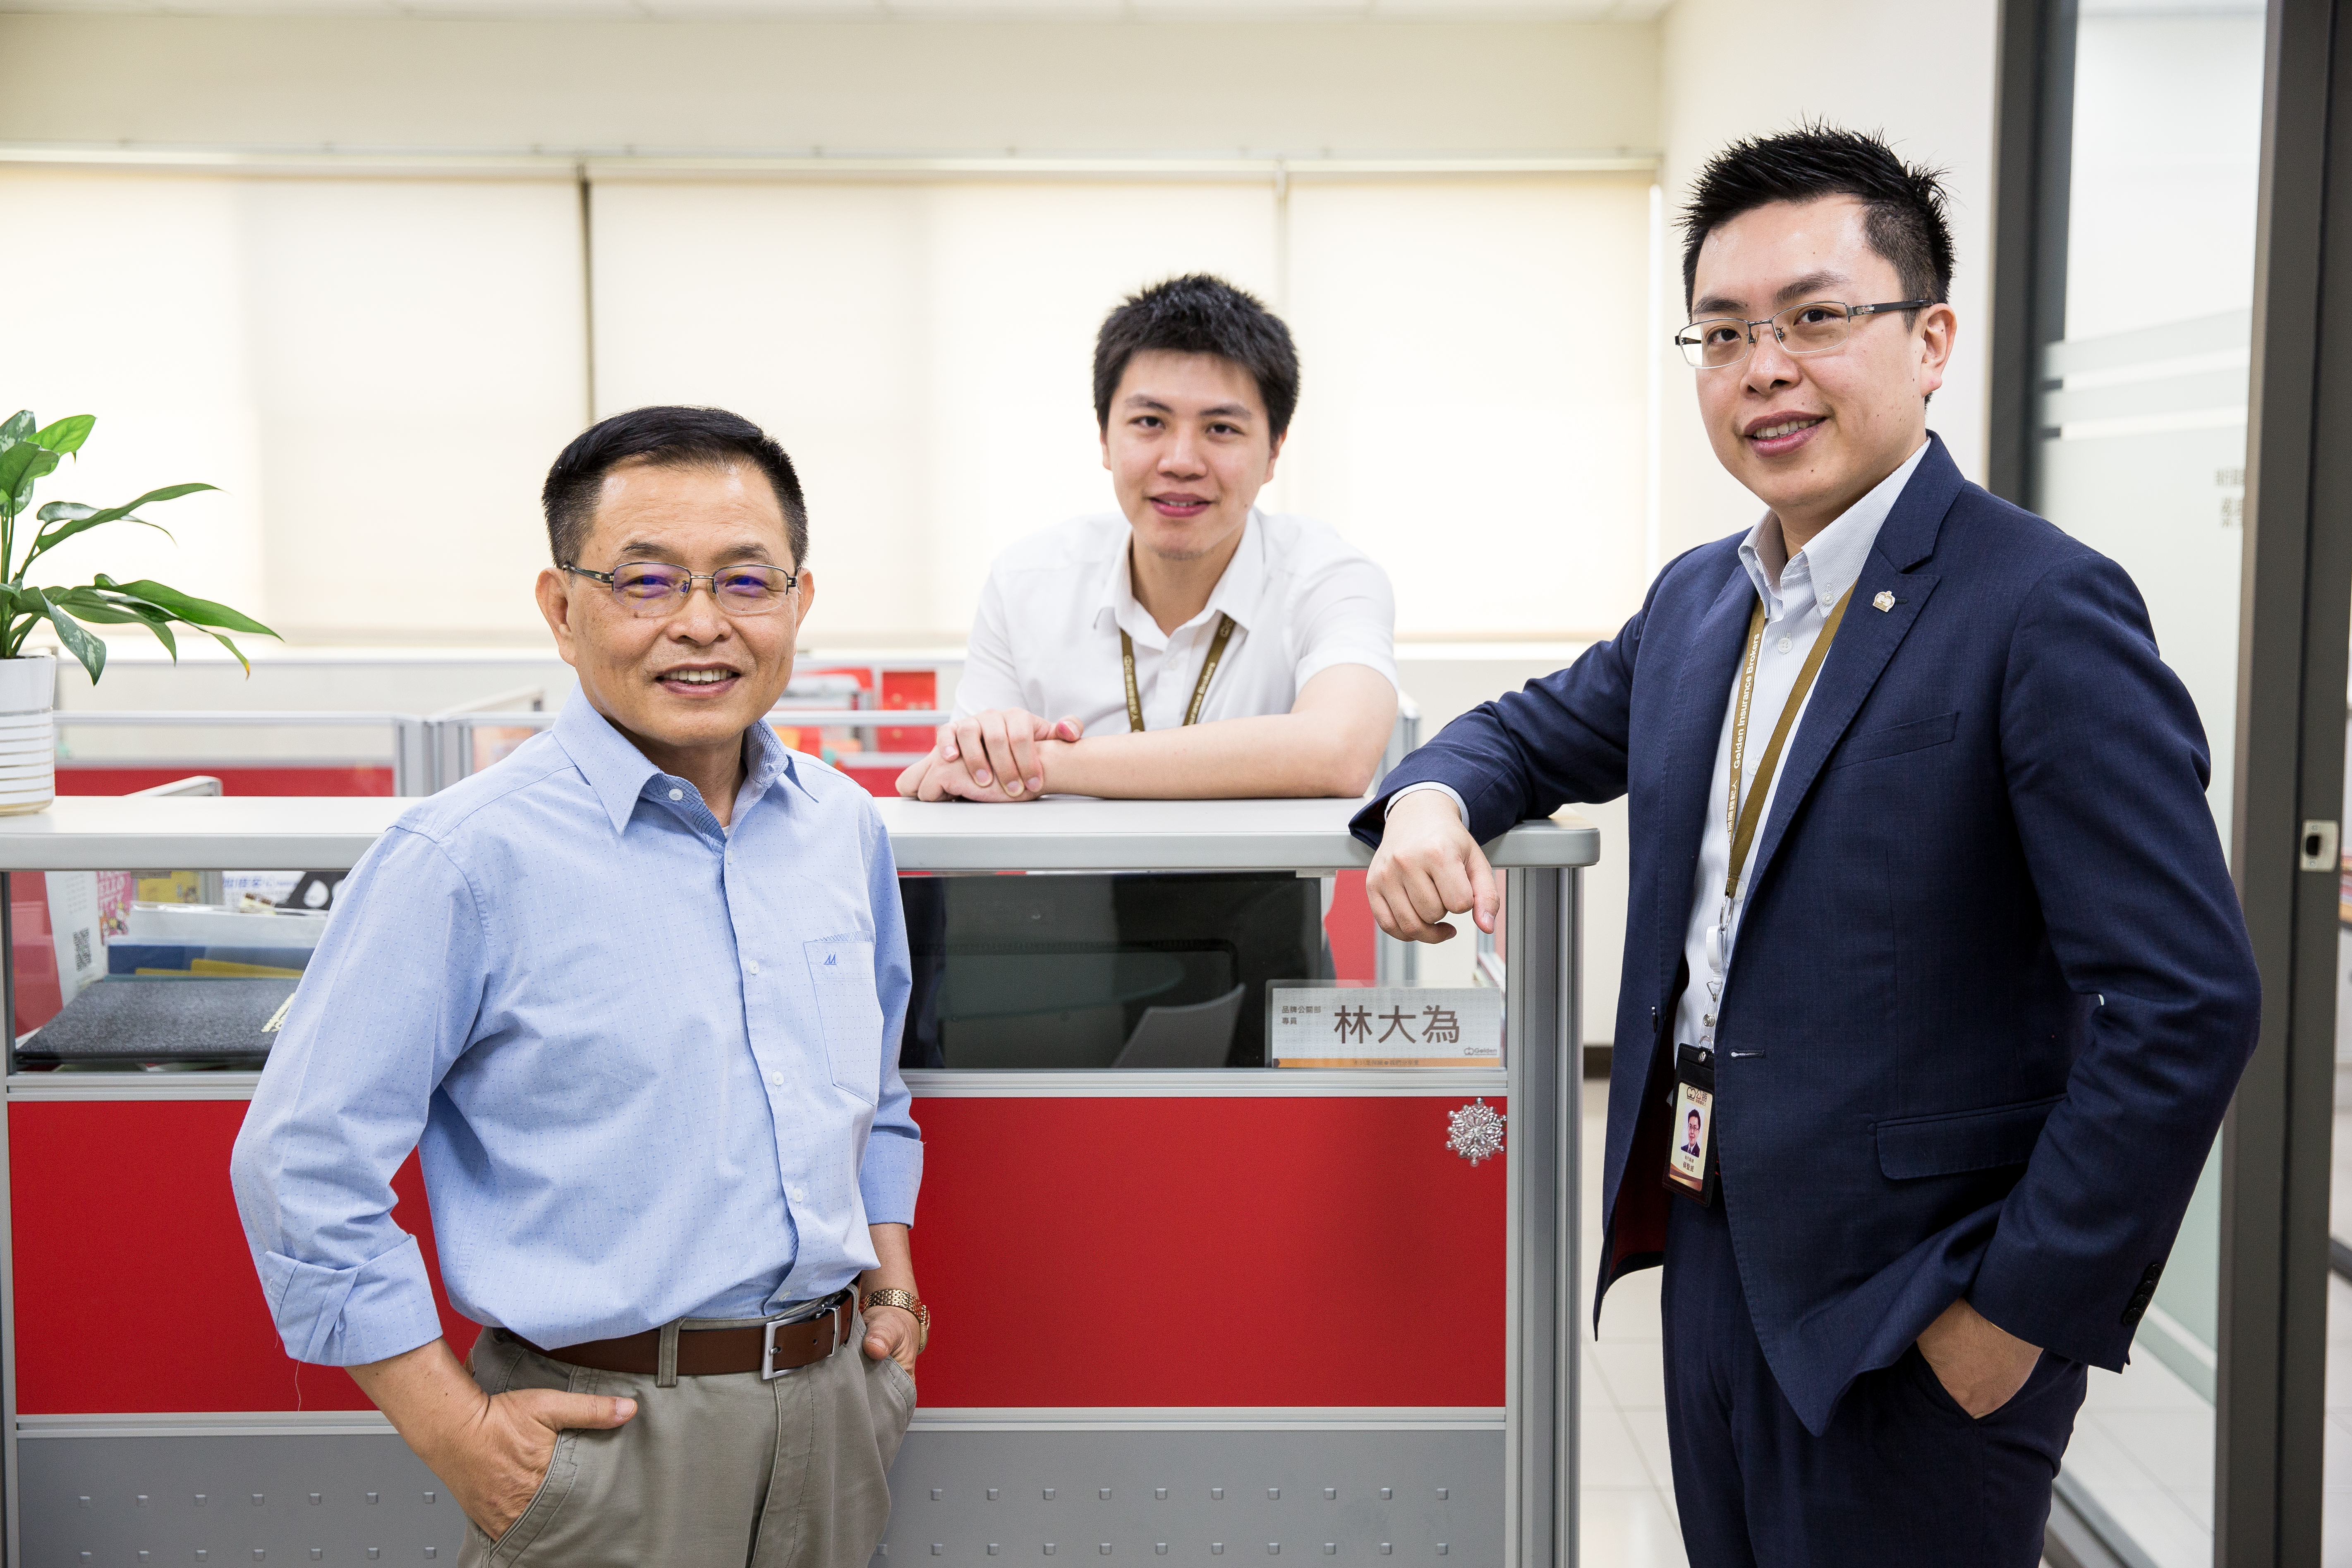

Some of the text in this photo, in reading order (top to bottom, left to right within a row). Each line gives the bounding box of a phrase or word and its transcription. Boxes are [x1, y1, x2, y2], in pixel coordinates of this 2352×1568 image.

[1734, 633, 1760, 769] Golden Insurance Brokers
[1334, 1005, 1459, 1044] 林大為
[1696, 1089, 1707, 1102] 公勝
